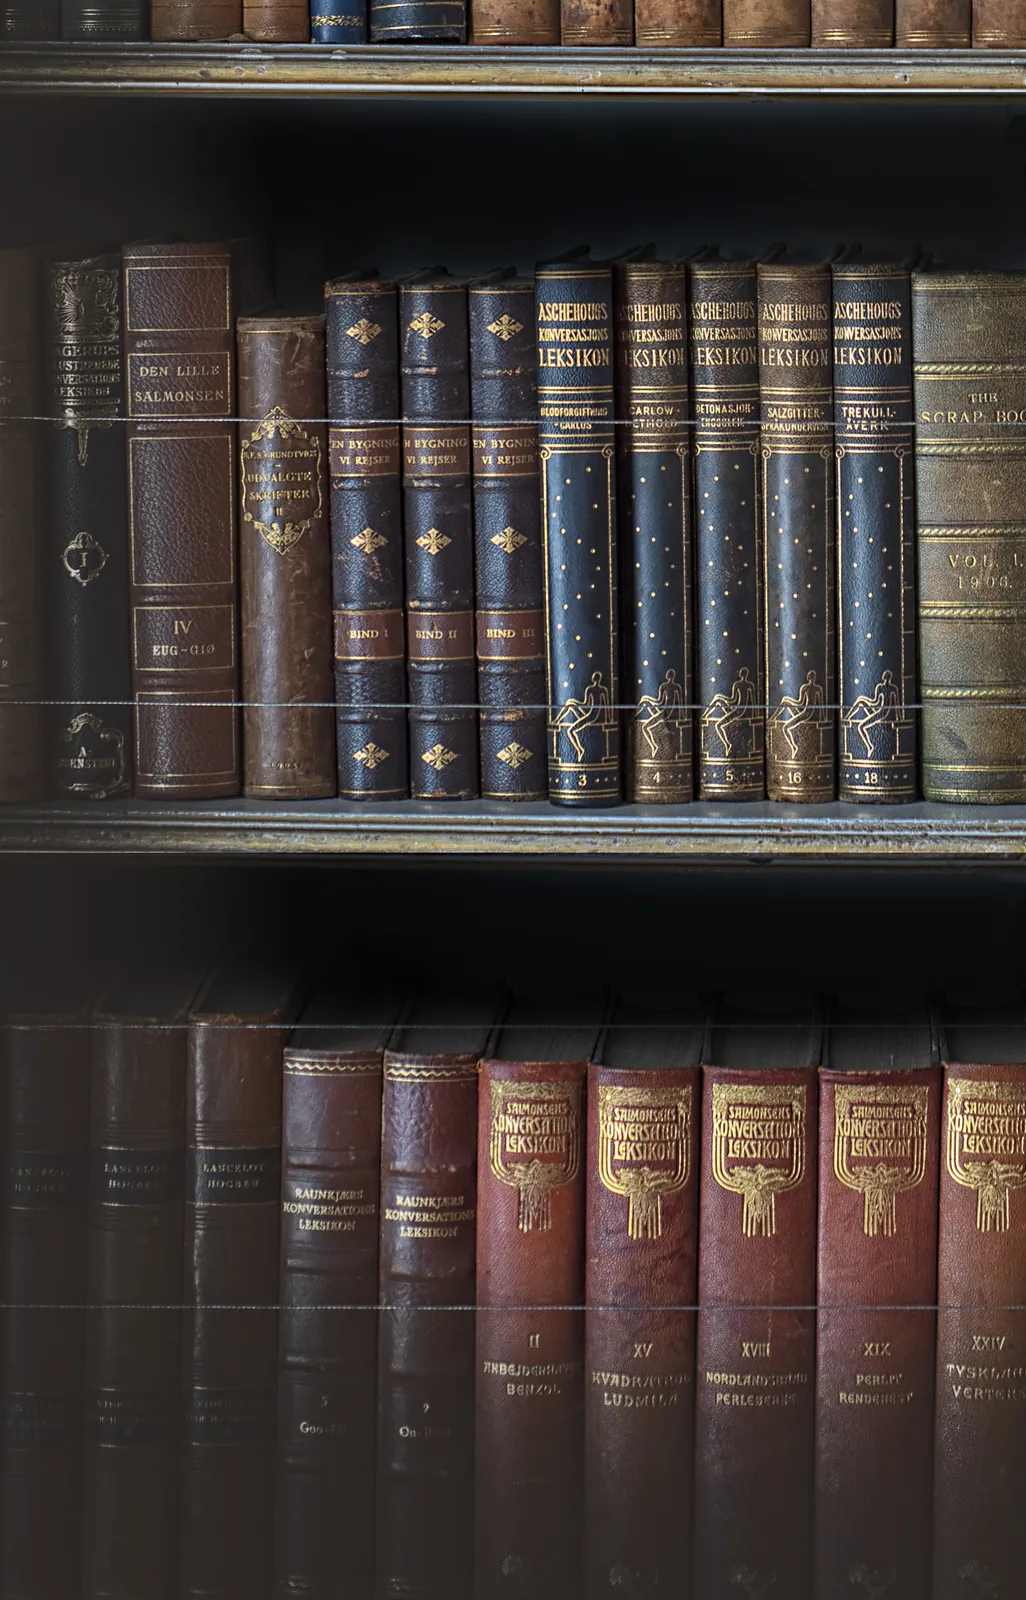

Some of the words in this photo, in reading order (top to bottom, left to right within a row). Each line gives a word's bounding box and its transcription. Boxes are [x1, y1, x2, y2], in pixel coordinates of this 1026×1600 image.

[539, 303, 608, 321] ASCHEHOUGS
[763, 303, 828, 321] ASCHEHOUGS
[539, 328, 608, 341] KONVERSASJONS
[762, 328, 828, 341] KONVERSASJONS
[539, 349, 609, 367] LEKSIKON
[762, 349, 828, 366] LEKSIKON
[835, 348, 901, 365] LEKSIKON
[139, 367, 168, 376] DEN
[176, 365, 220, 375] LILLE
[135, 390, 223, 402] SALMONSEN
[968, 393, 997, 403] THE
[921, 411, 982, 423] SCRAP
[340, 456, 349, 464] VI
[355, 456, 390, 464] REJSER
[174, 620, 193, 634] IV
[579, 775, 587, 786] 3
[653, 772, 660, 782] 4
[788, 772, 801, 783] 16
[864, 772, 877, 783] 18
[506, 1135, 566, 1152] LEKSIKON
[614, 1141, 675, 1160] LEKSIKON
[295, 1189, 363, 1200] RAUNKJÆRS
[283, 1203, 375, 1217] KONVERSATIONS
[385, 1210, 474, 1223] KONVERSATIONS
[298, 1219, 355, 1231] LEKSIKON
[400, 1226, 457, 1238] LEKSIKON
[633, 1344, 652, 1357] XV
